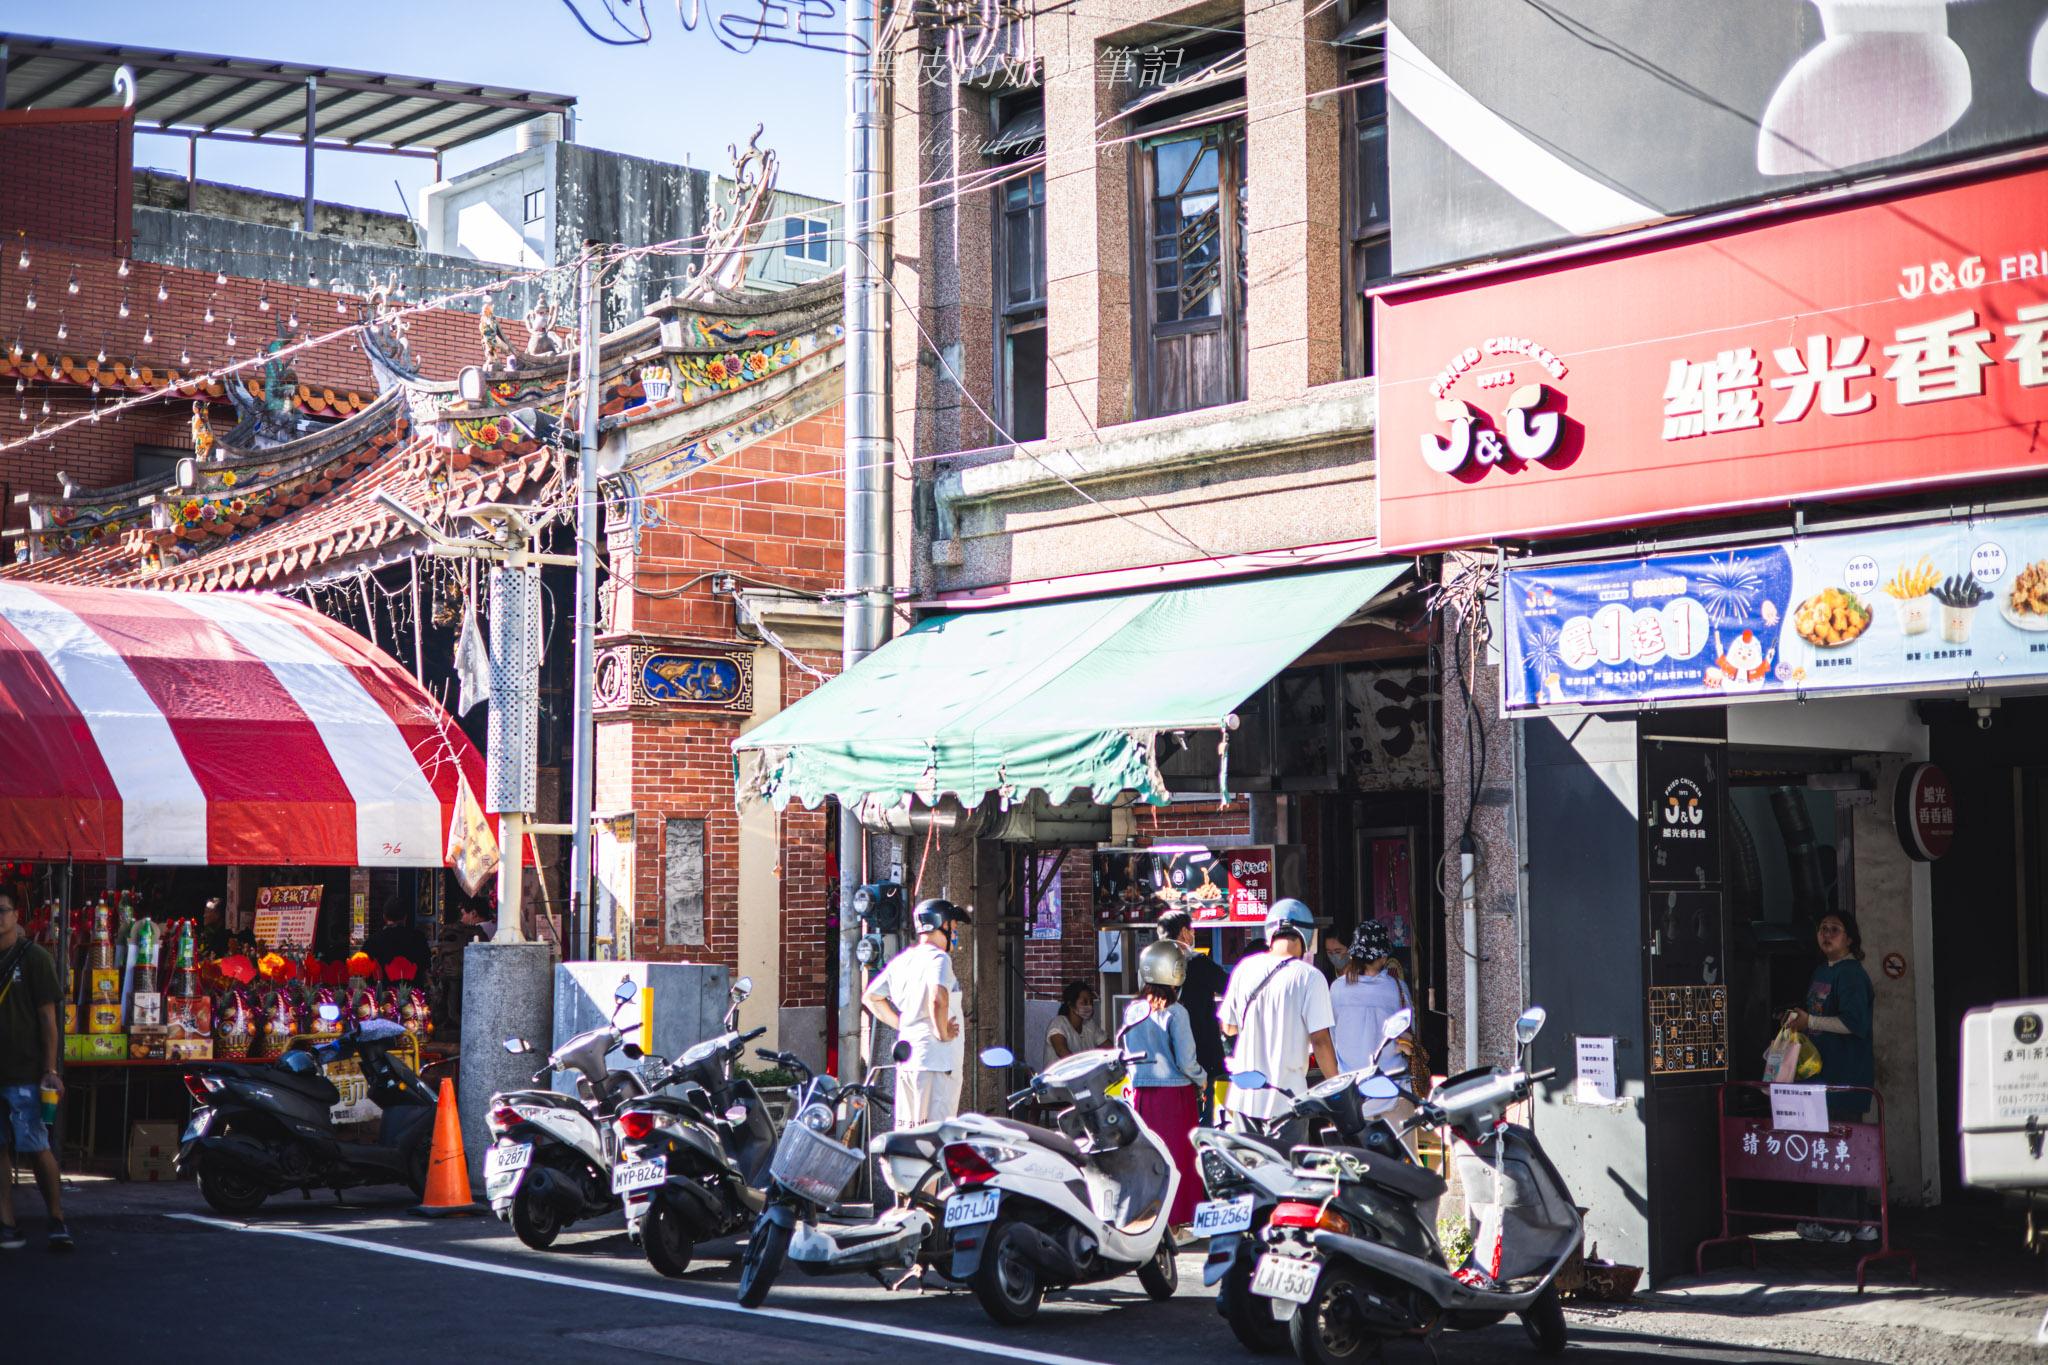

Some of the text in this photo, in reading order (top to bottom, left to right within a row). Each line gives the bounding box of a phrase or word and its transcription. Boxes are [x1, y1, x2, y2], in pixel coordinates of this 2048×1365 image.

[1897, 256, 1986, 299] J&G
[1483, 336, 1569, 380] CHICKEN
[1420, 384, 1570, 476] J&G
[1563, 602, 1691, 665] 買1送1
[382, 842, 402, 856] 36
[1236, 888, 1268, 901] 不使用
[1236, 903, 1267, 915] 回鍋油
[1742, 1132, 1851, 1163] 請勿 停車
[615, 1163, 664, 1187] MYP-8262
[946, 1199, 996, 1223] 807-LJA
[1196, 1205, 1250, 1228] MEB-2563
